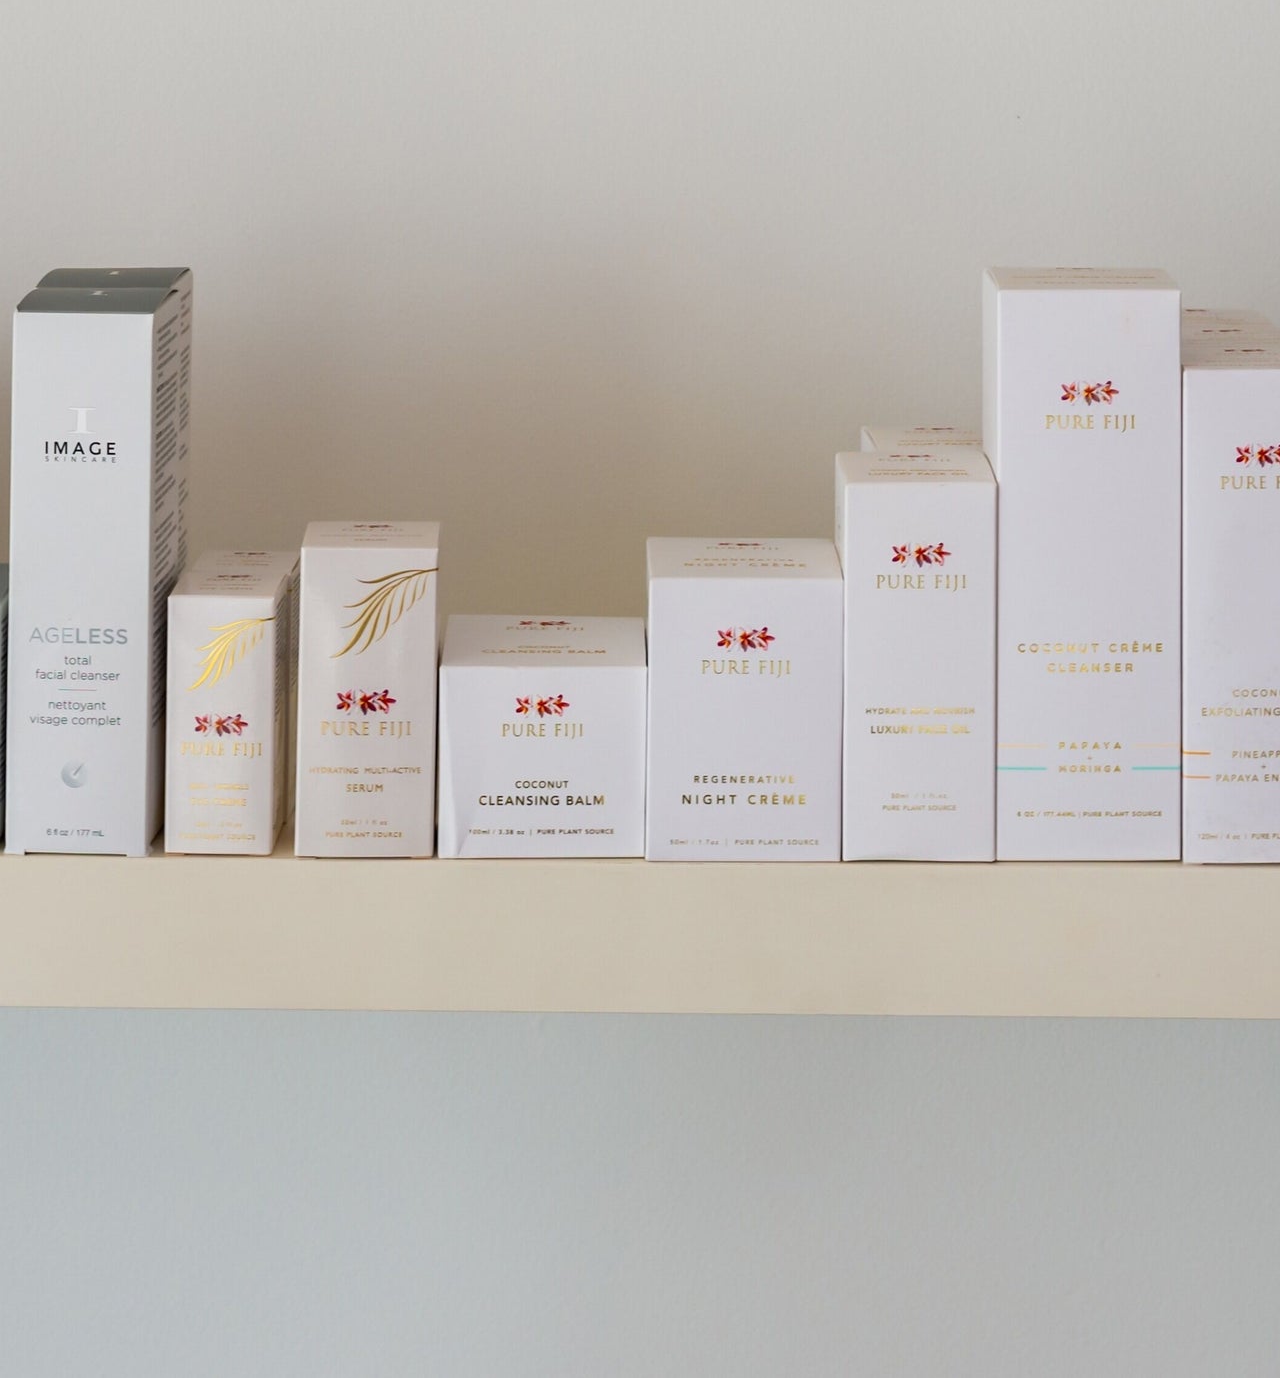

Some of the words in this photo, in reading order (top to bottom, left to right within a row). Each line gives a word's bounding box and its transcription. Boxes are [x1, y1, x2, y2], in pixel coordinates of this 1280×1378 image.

[46, 442, 115, 455] IMAGE
[1221, 476, 1266, 489] PURE
[29, 627, 127, 644] AGELESS
[64, 656, 91, 665] total
[702, 659, 749, 674] PURE
[759, 660, 790, 678] FIJI
[1048, 663, 1133, 672] CLEANSER
[36, 669, 66, 679] facial
[71, 671, 120, 681] cleanser
[49, 701, 106, 712] nettoyant
[1202, 707, 1280, 716] EXFOLIATING
[30, 716, 68, 726] visage
[72, 716, 121, 726] complet
[502, 724, 546, 737] PURE
[555, 724, 583, 739] FIJI
[1216, 774, 1259, 782] PAPAYA
[347, 784, 383, 792] SERUM
[479, 796, 559, 805] CLEANSING
[567, 796, 603, 805] BALM
[682, 795, 736, 804] NIGHT
